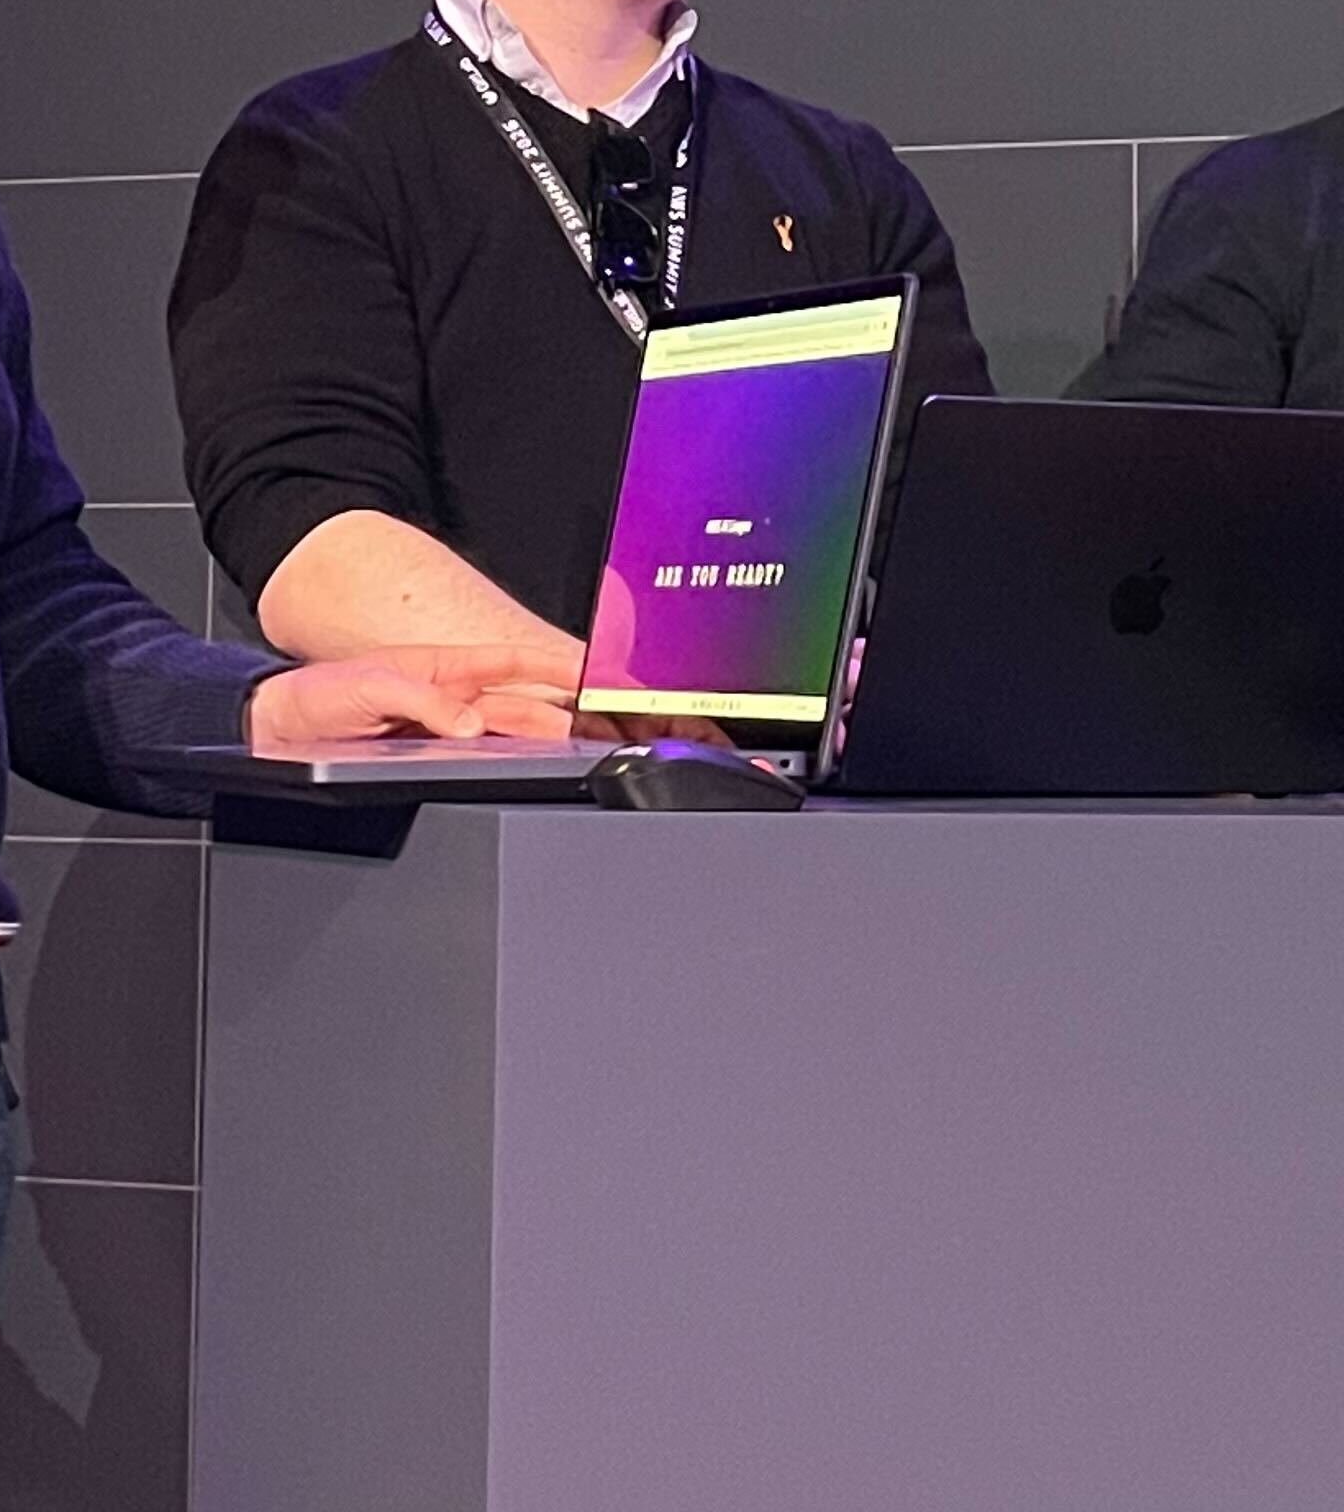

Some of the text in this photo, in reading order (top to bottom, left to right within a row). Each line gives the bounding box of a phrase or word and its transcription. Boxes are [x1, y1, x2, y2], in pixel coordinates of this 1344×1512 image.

[531, 160, 584, 231] SUMMIT
[668, 186, 687, 220] AWS
[665, 224, 684, 296] SUMMIT
[690, 565, 720, 587] YOU
[725, 563, 784, 587] READY?
